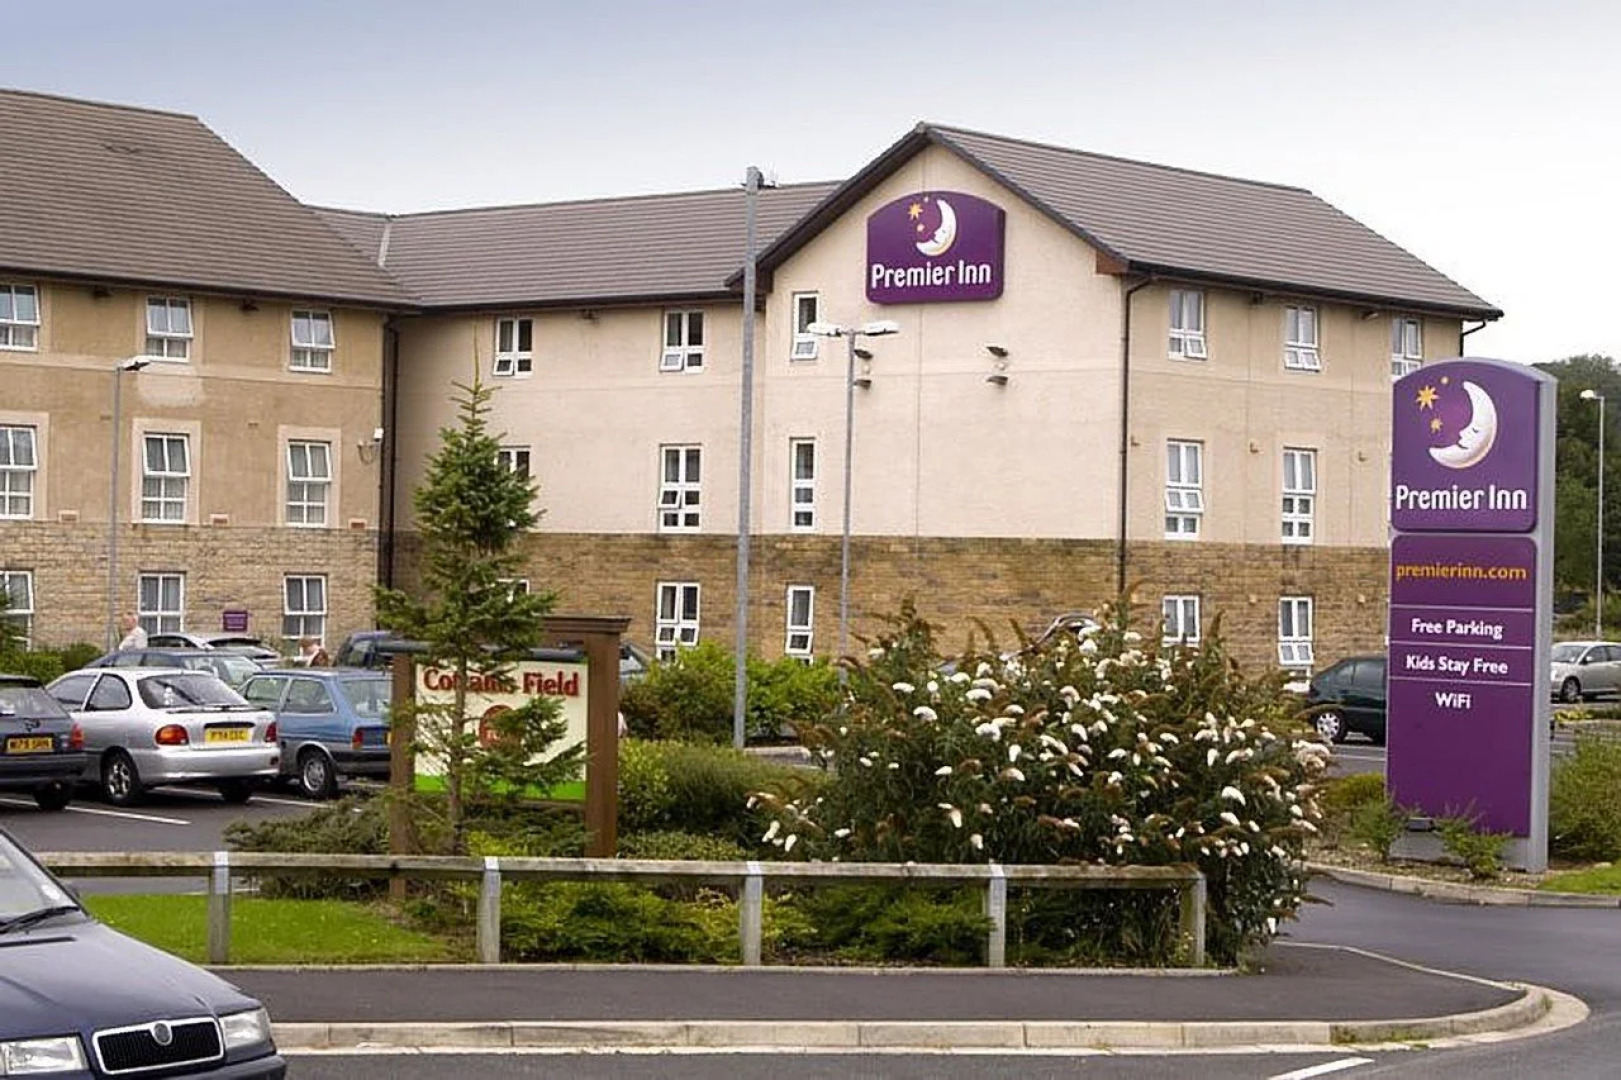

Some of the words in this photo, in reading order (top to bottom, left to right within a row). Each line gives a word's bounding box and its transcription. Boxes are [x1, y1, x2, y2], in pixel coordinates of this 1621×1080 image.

[871, 261, 955, 289] Premier
[957, 259, 992, 285] Inn
[1395, 484, 1484, 510] Premier
[1488, 484, 1527, 510] Inn
[1396, 562, 1527, 581] premierinn.com
[1411, 618, 1443, 634] Free
[1446, 619, 1503, 640] Parking
[1406, 654, 1435, 671] Kids
[1438, 655, 1470, 676] Stay
[1473, 658, 1508, 675] Free
[522, 670, 580, 697] Field
[1435, 691, 1471, 710] WiFi
